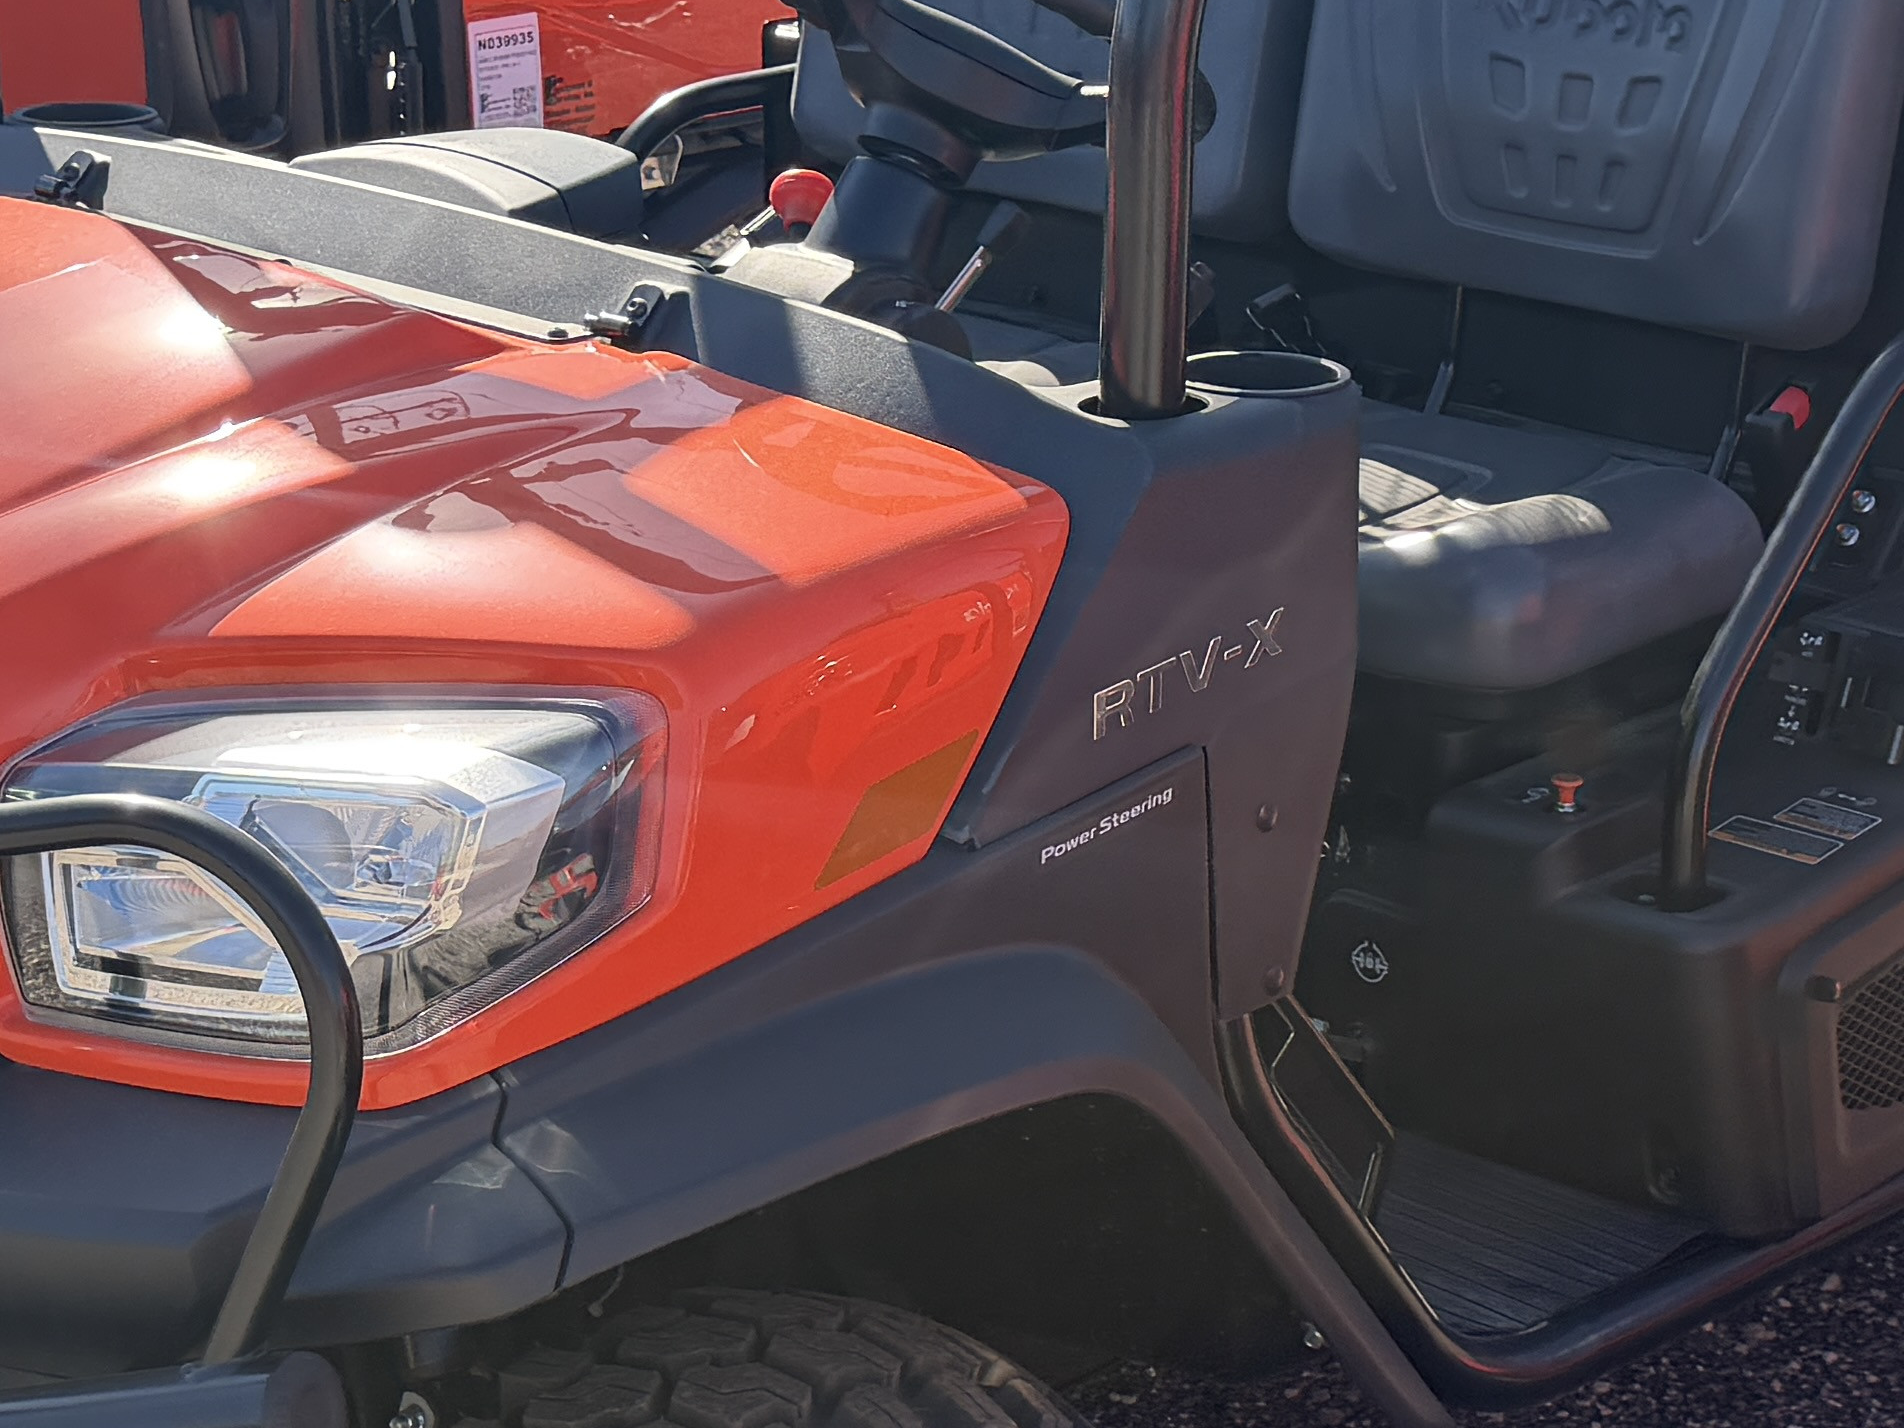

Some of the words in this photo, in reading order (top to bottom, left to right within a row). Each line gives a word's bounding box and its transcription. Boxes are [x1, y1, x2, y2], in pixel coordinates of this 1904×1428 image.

[1093, 606, 1284, 741] RTV-X
[1040, 827, 1098, 865] Power
[1099, 786, 1174, 836] Steering
